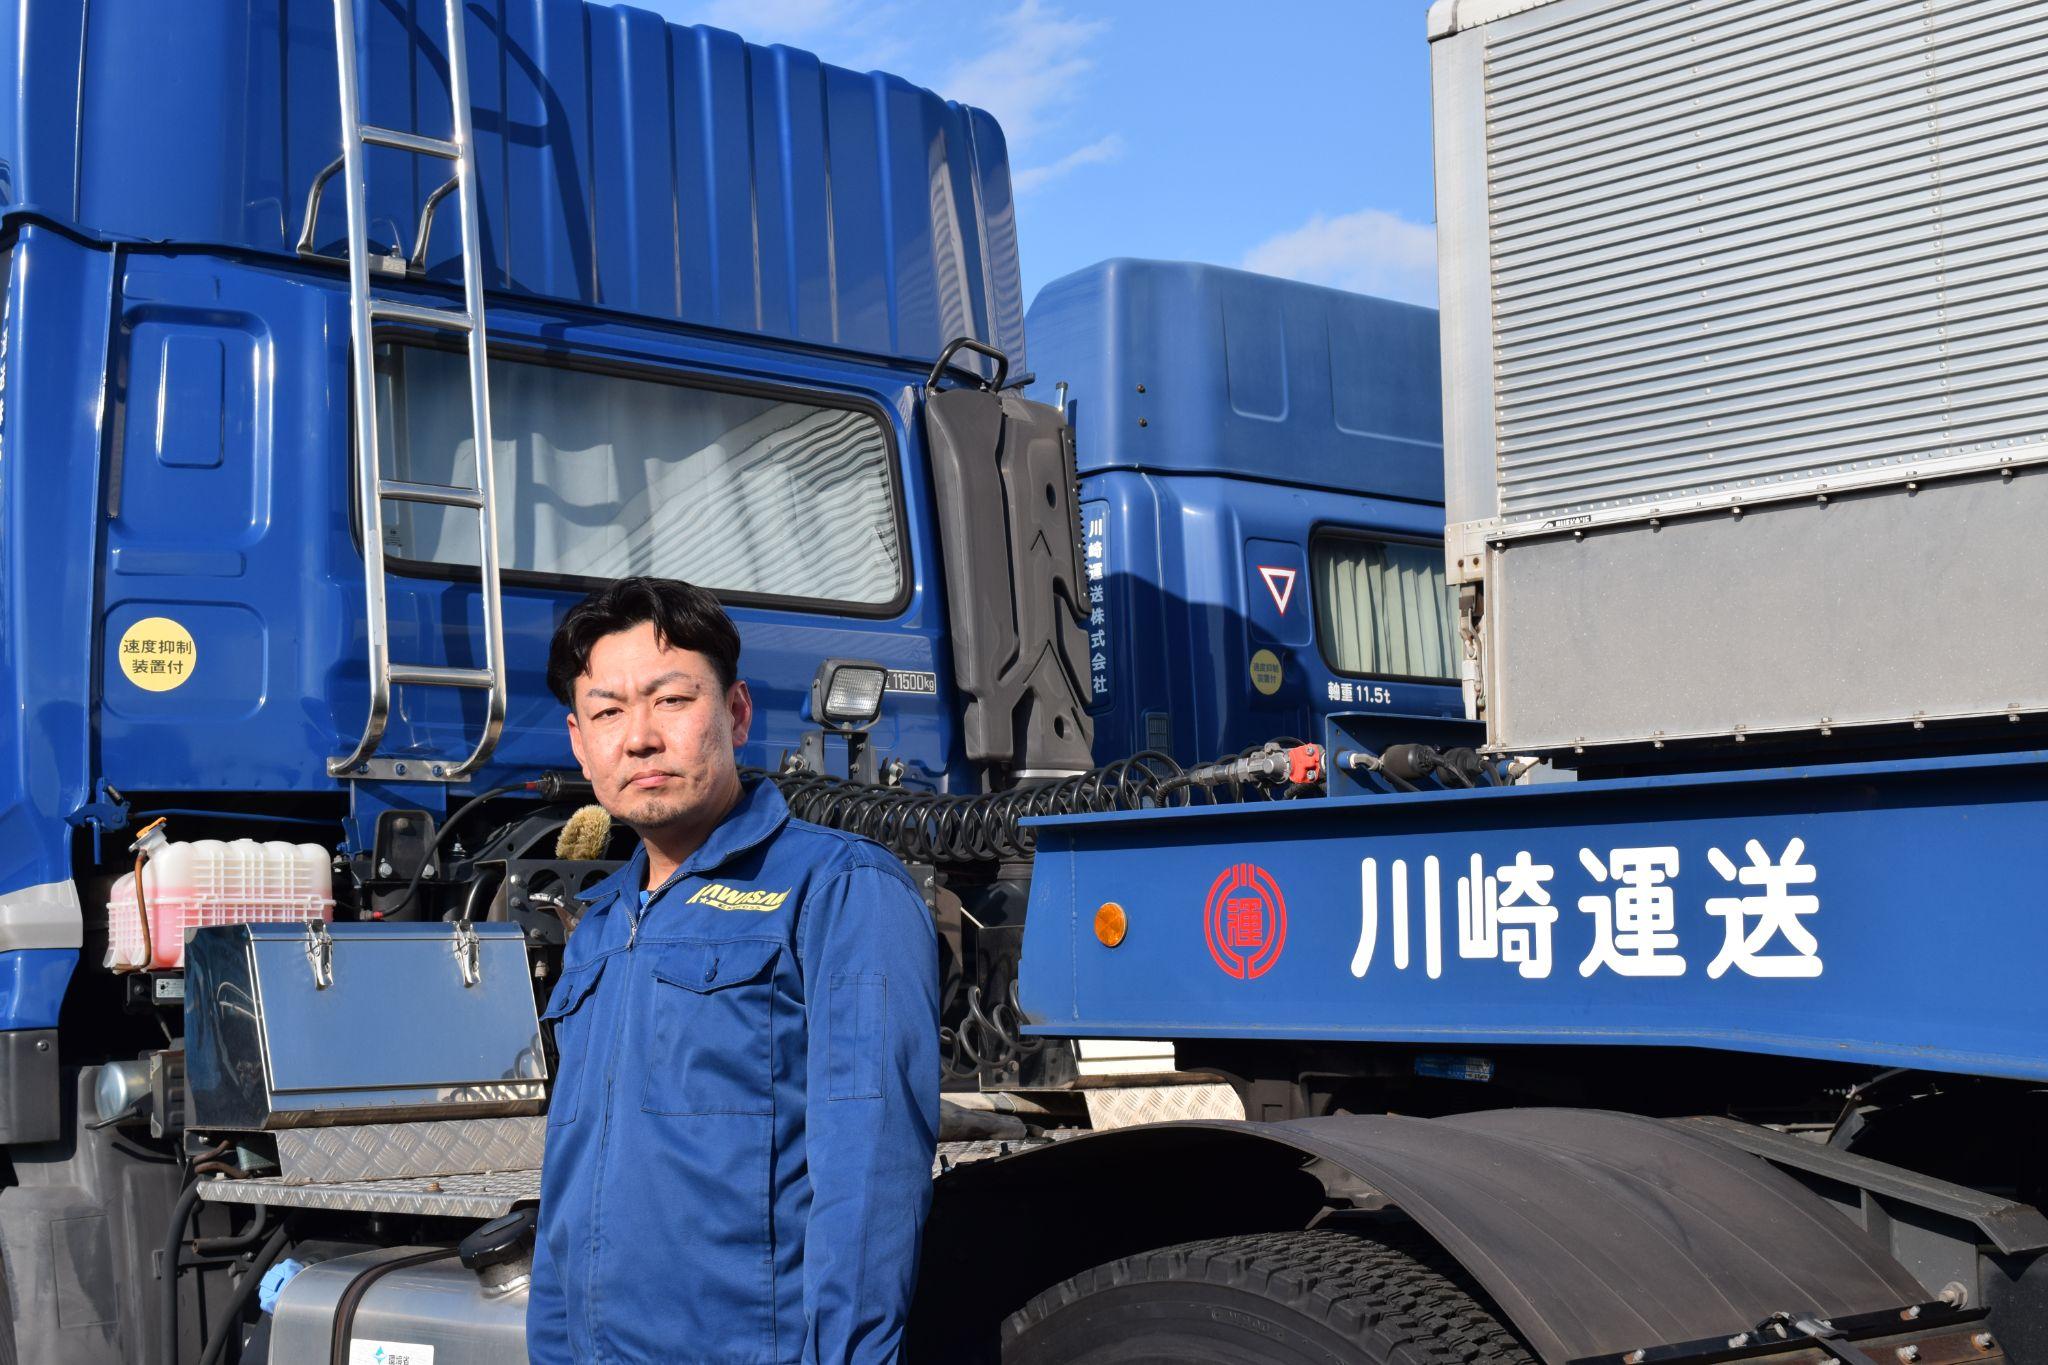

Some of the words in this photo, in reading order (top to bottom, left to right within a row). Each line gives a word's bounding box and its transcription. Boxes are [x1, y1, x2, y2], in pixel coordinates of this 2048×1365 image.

[1088, 518, 1108, 694] 川崎運送株式会社
[123, 639, 193, 655] 速度抑制
[132, 659, 184, 675] 装置付
[892, 672, 935, 692] 11500kg
[1356, 685, 1391, 704] 11.5t
[1351, 837, 1824, 980] 川崎運送
